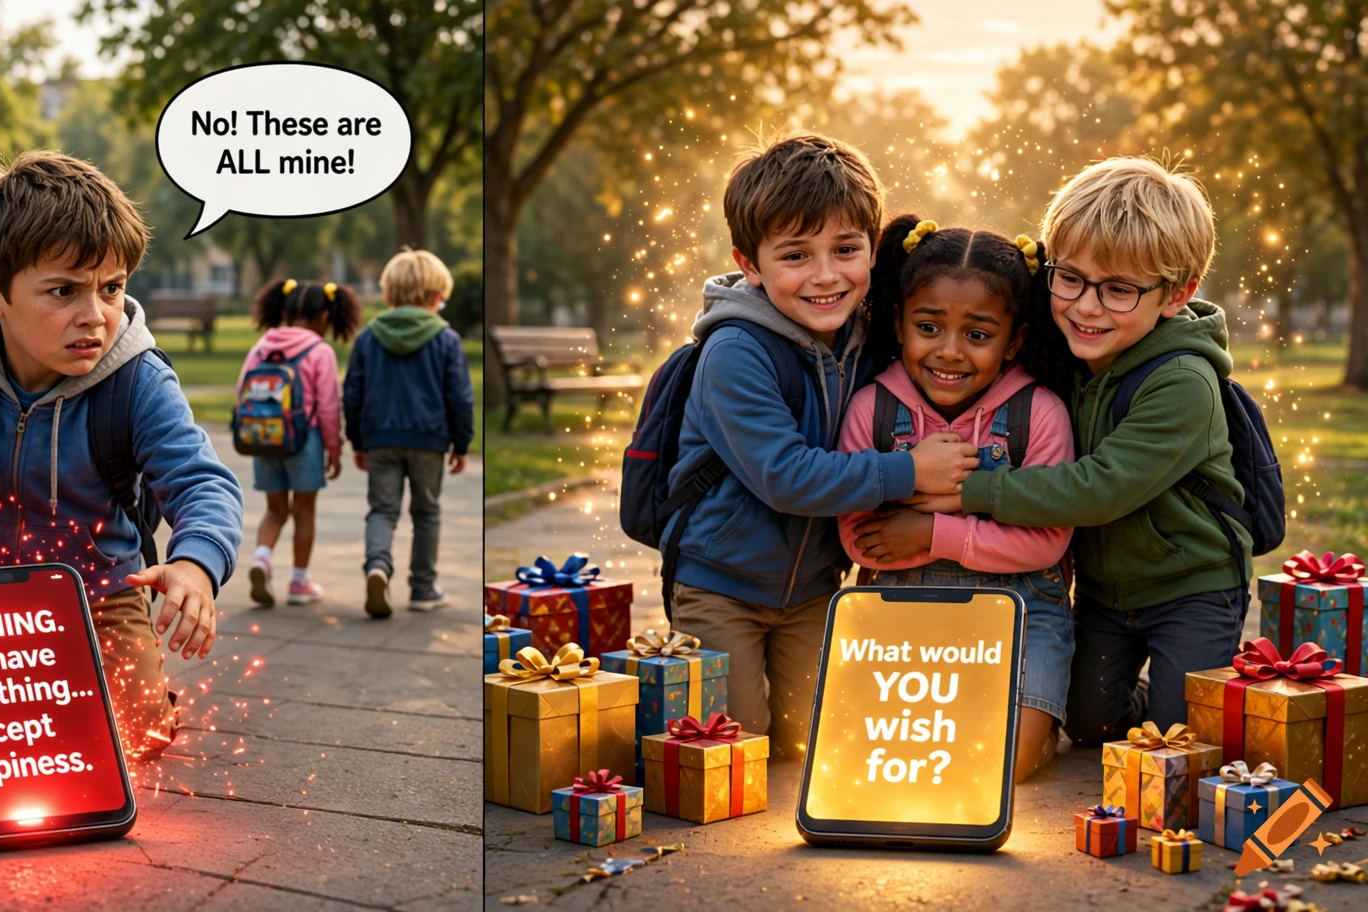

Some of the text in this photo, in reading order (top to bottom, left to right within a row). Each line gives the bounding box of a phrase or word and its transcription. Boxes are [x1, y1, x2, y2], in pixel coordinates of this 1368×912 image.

[840, 638, 1003, 664] What would
[873, 671, 959, 703] YOU
[864, 708, 956, 742] wish
[866, 748, 951, 785] for?
